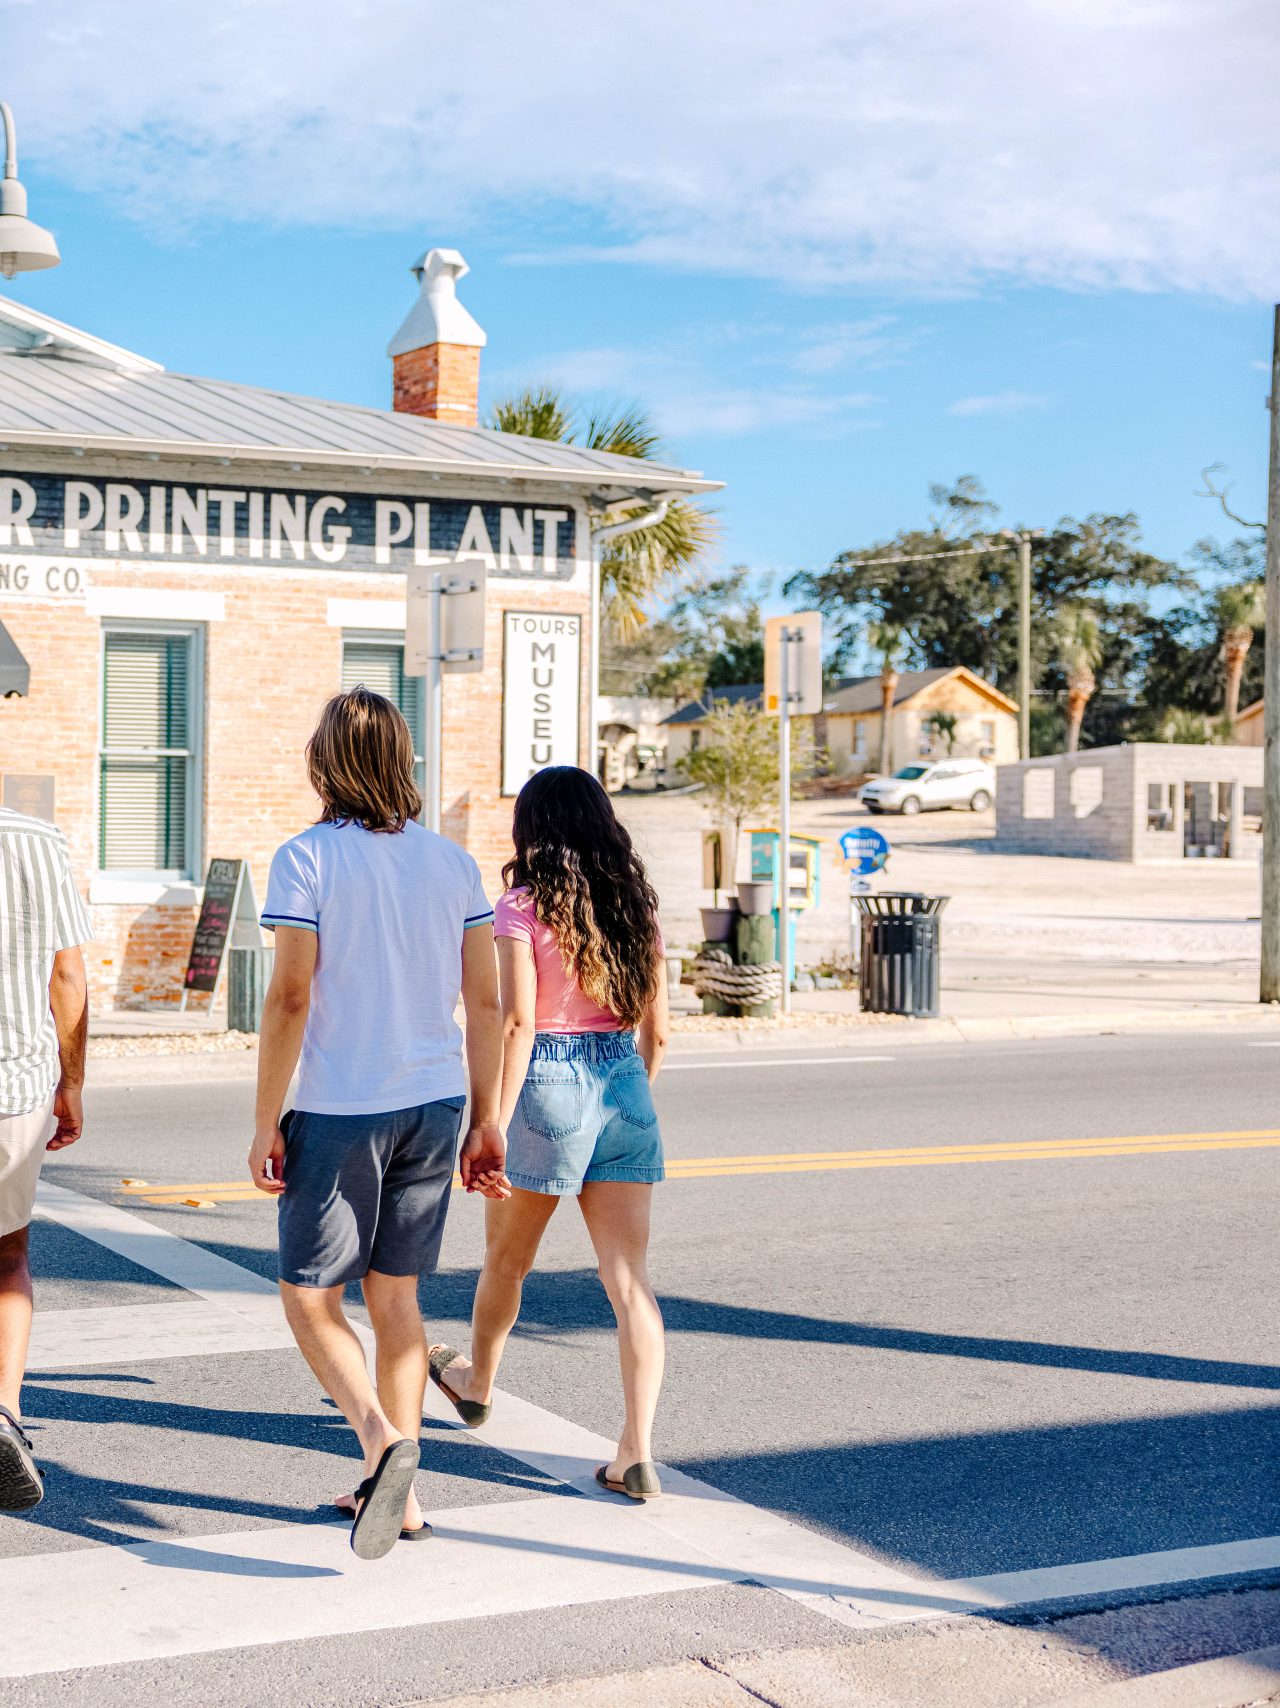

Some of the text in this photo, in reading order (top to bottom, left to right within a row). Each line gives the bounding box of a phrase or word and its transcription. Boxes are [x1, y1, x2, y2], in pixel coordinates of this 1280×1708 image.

[64, 480, 352, 563] PRINTING
[375, 500, 568, 573] PLANT
[45, 566, 84, 593] CO.
[511, 617, 577, 636] TOURS
[528, 641, 555, 778] MUSEU
